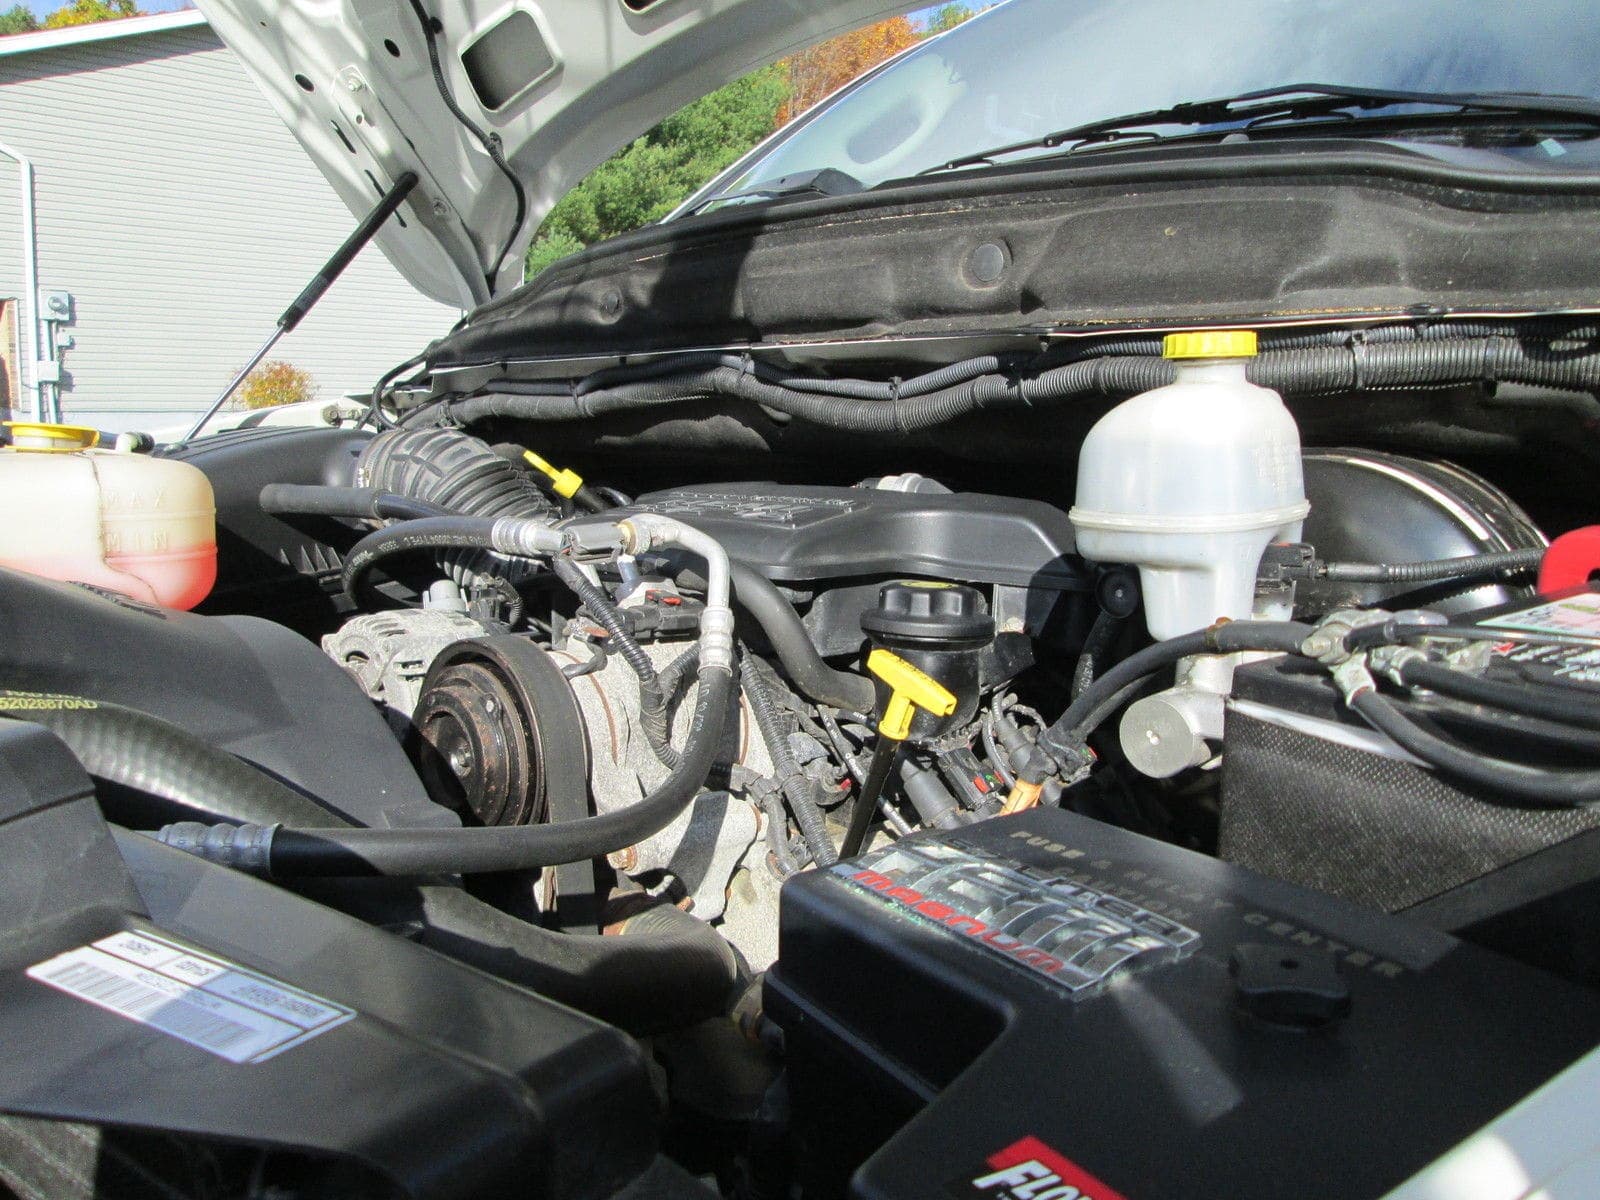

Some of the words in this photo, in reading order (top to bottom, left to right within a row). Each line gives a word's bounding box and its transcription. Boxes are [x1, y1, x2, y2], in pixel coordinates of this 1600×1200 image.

[1009, 831, 1086, 859] FUSE
[1241, 913, 1405, 977] CENTER
[972, 1159, 1092, 1200] FLO
